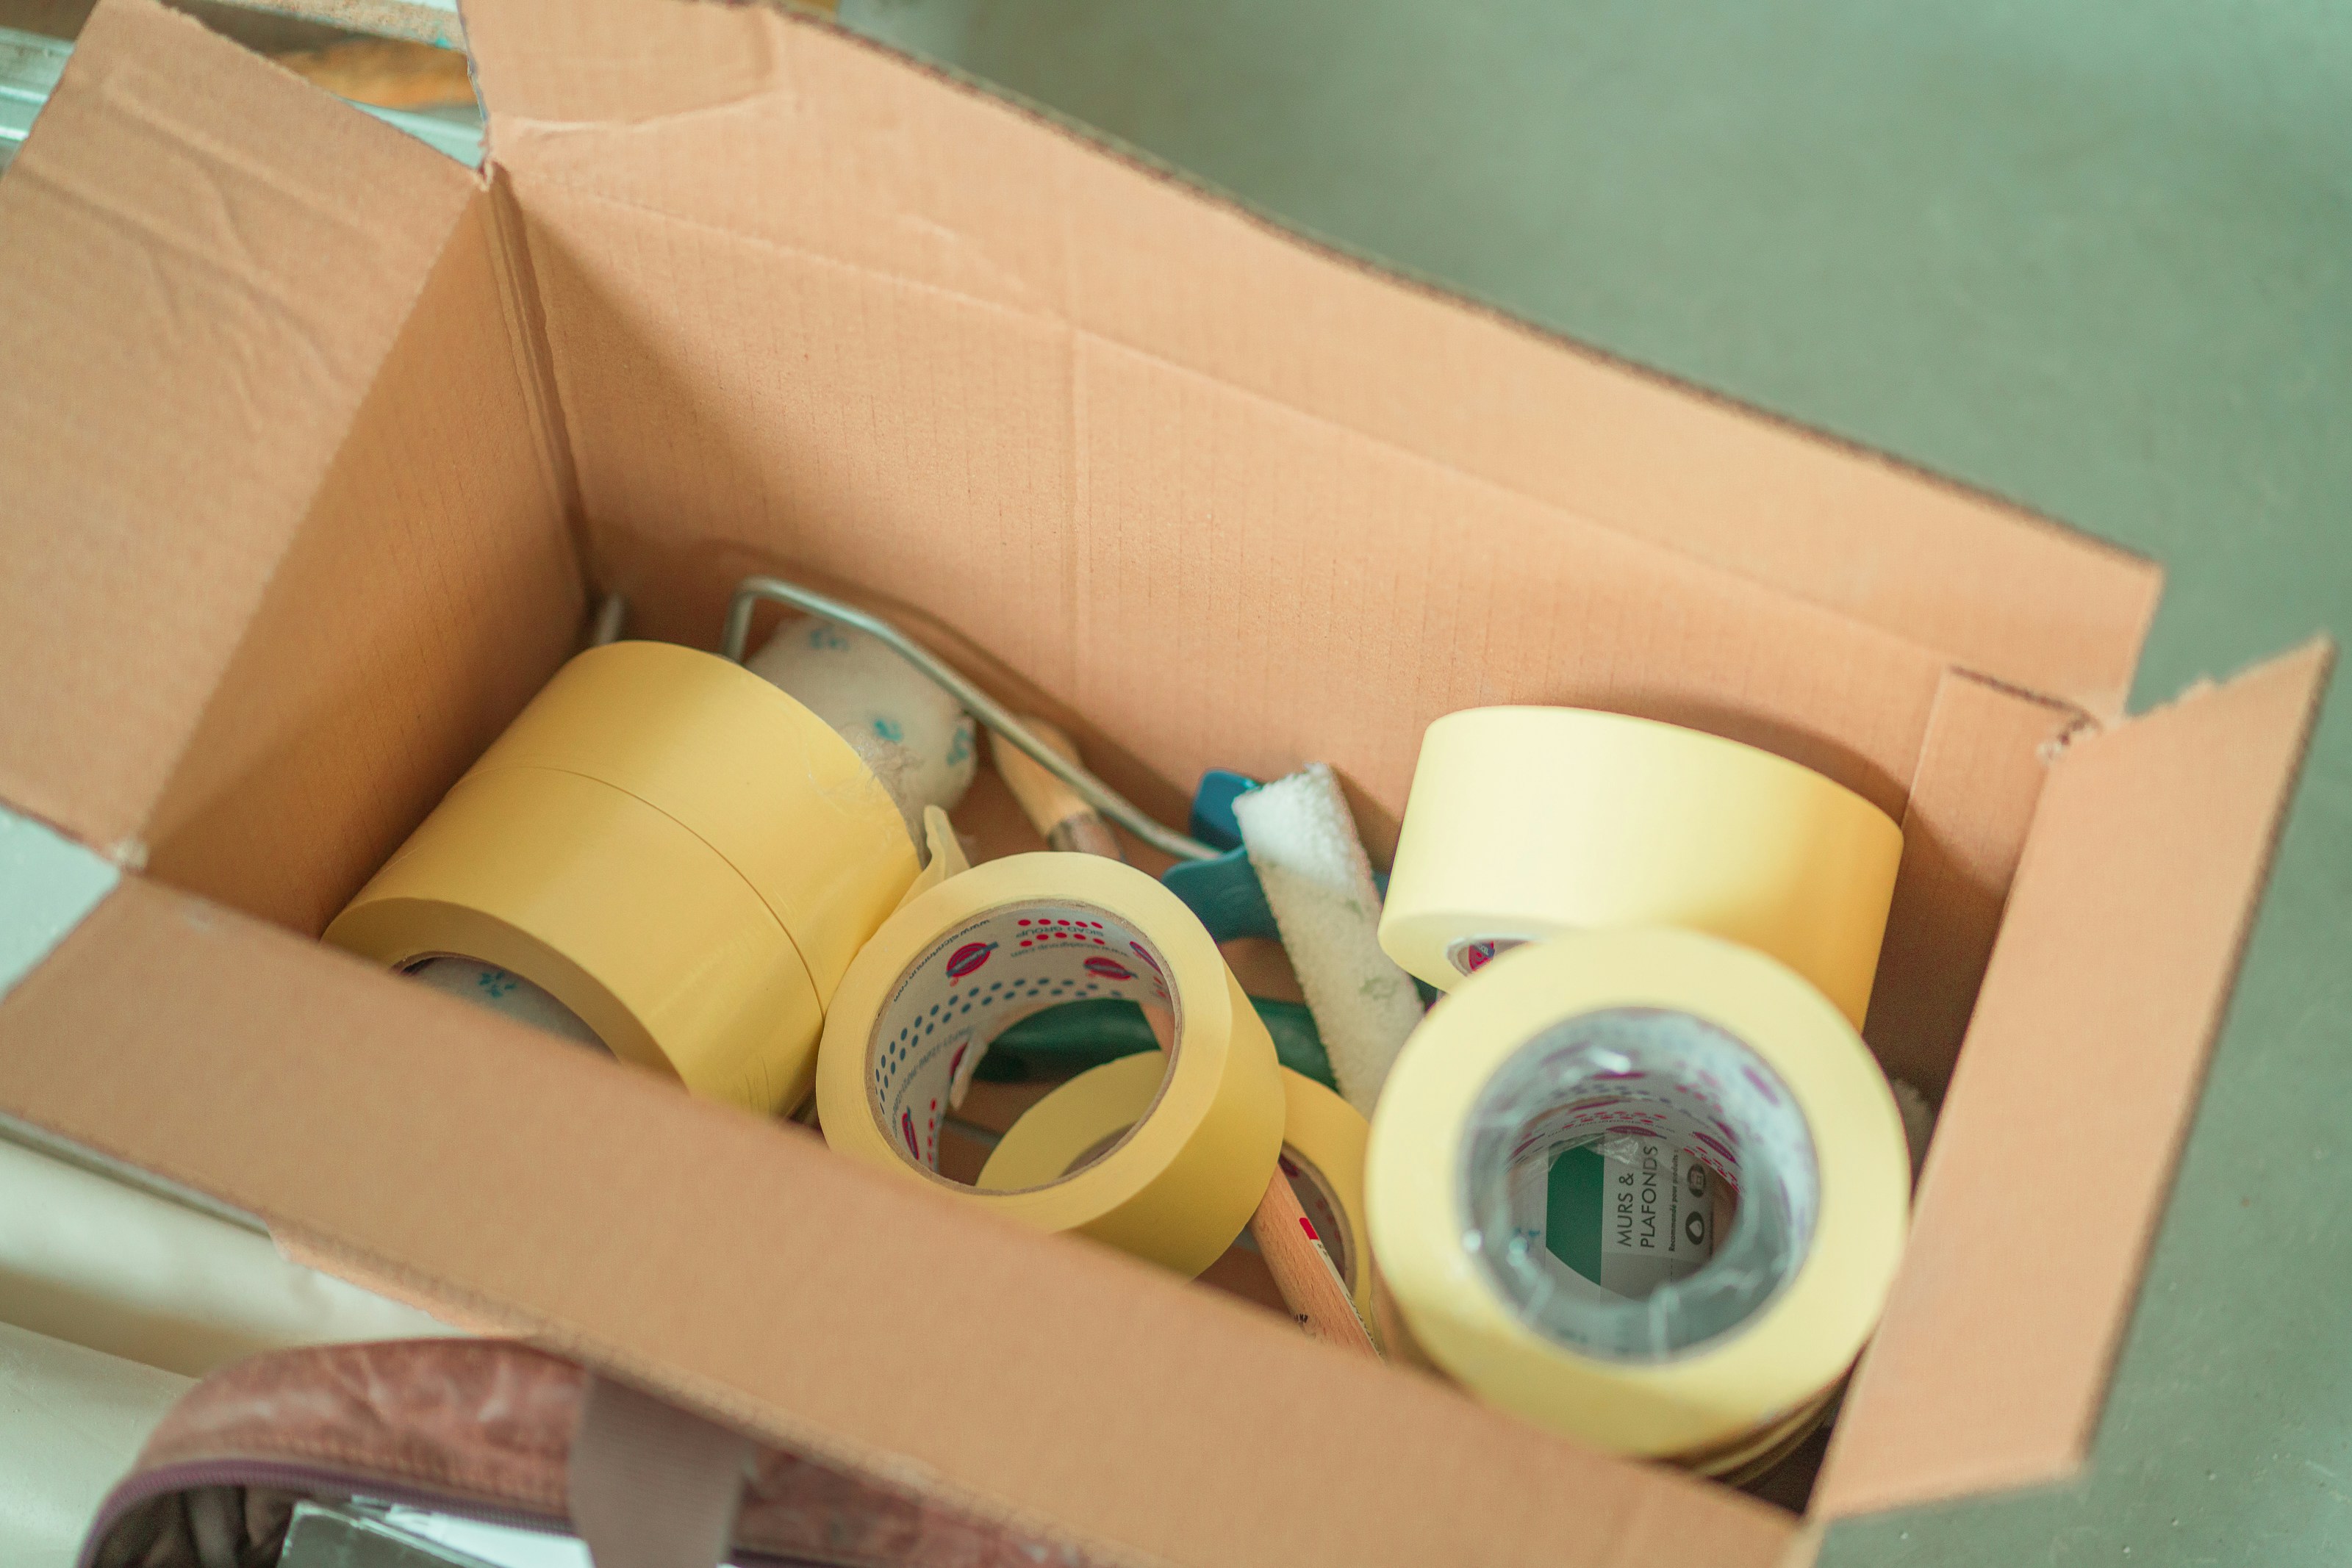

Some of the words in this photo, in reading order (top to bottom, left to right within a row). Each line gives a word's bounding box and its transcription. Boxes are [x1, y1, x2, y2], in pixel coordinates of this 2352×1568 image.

[1016, 926, 1063, 938] GROUP
[1067, 926, 1105, 938] SICAD
[1618, 1173, 1634, 1187] &
[1640, 1146, 1658, 1248] PLAFONDS
[1671, 1185, 1679, 1203] pour
[1617, 1193, 1634, 1248] MURS
[1668, 1204, 1677, 1252] Recommandé
